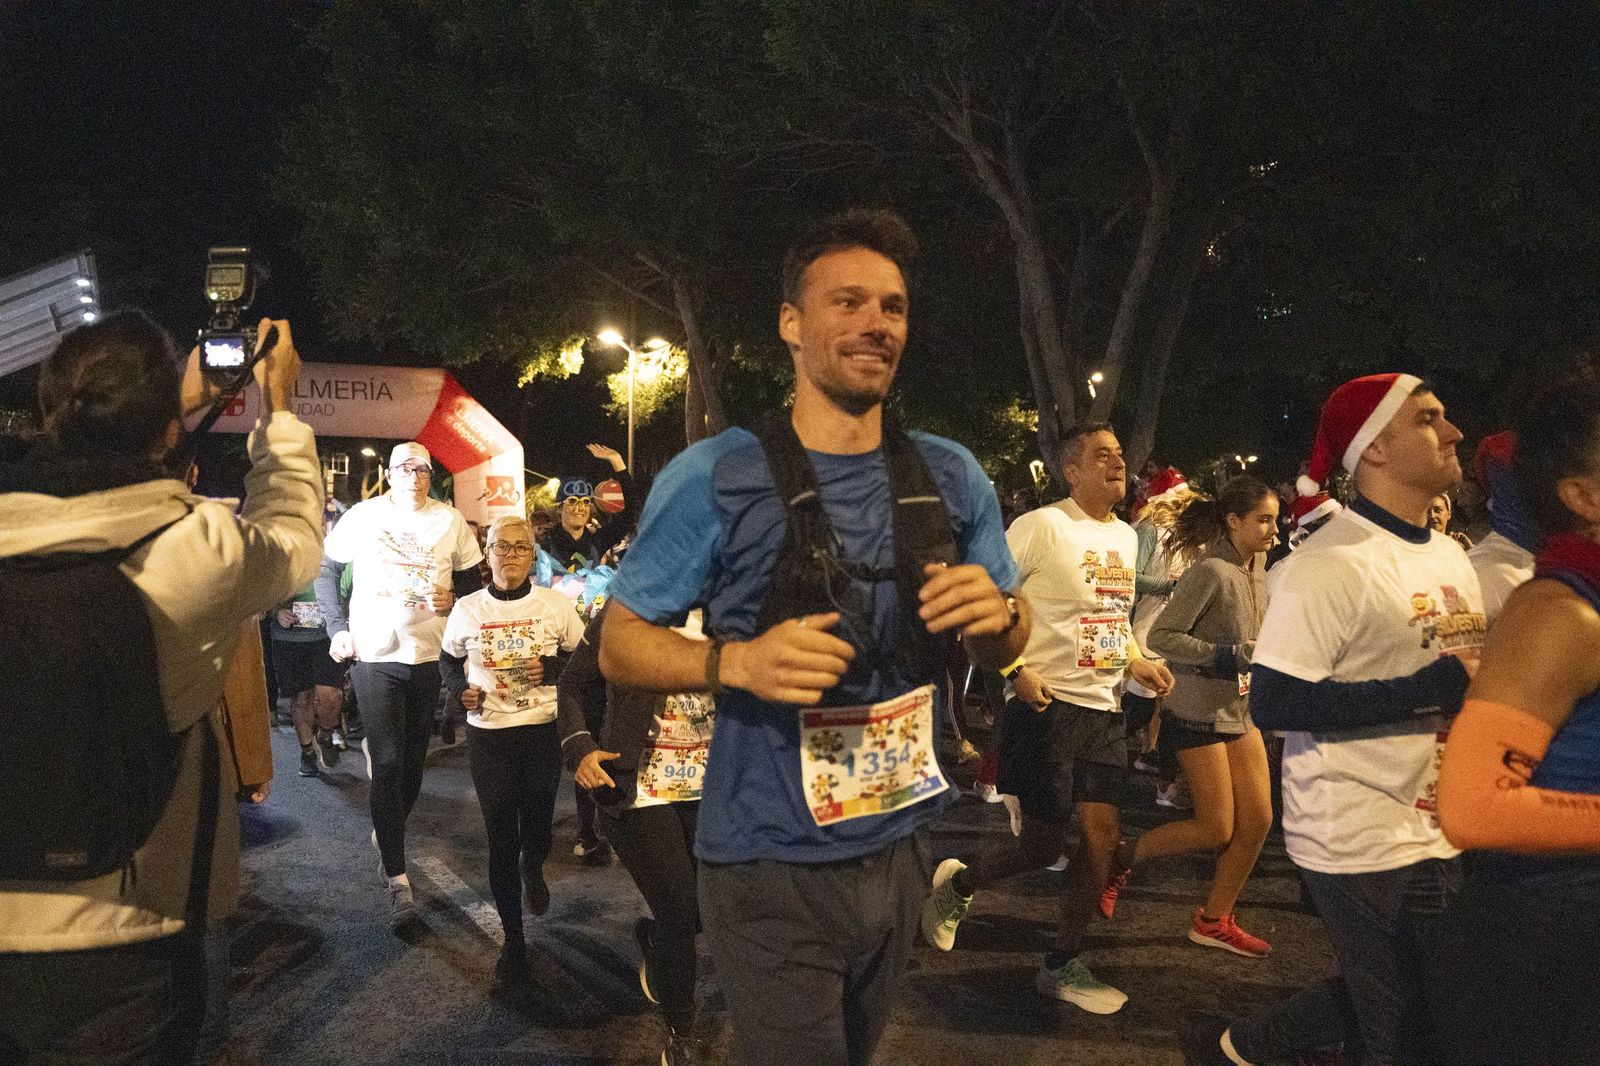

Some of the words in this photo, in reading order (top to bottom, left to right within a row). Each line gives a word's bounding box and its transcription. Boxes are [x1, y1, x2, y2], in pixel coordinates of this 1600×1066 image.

[289, 378, 393, 401] LMERÍA
[291, 402, 335, 417] UDAD
[451, 420, 488, 455] deporte
[497, 638, 525, 651] 829
[1100, 637, 1121, 648] 661
[844, 742, 911, 777] 1354
[664, 765, 697, 779] 940
